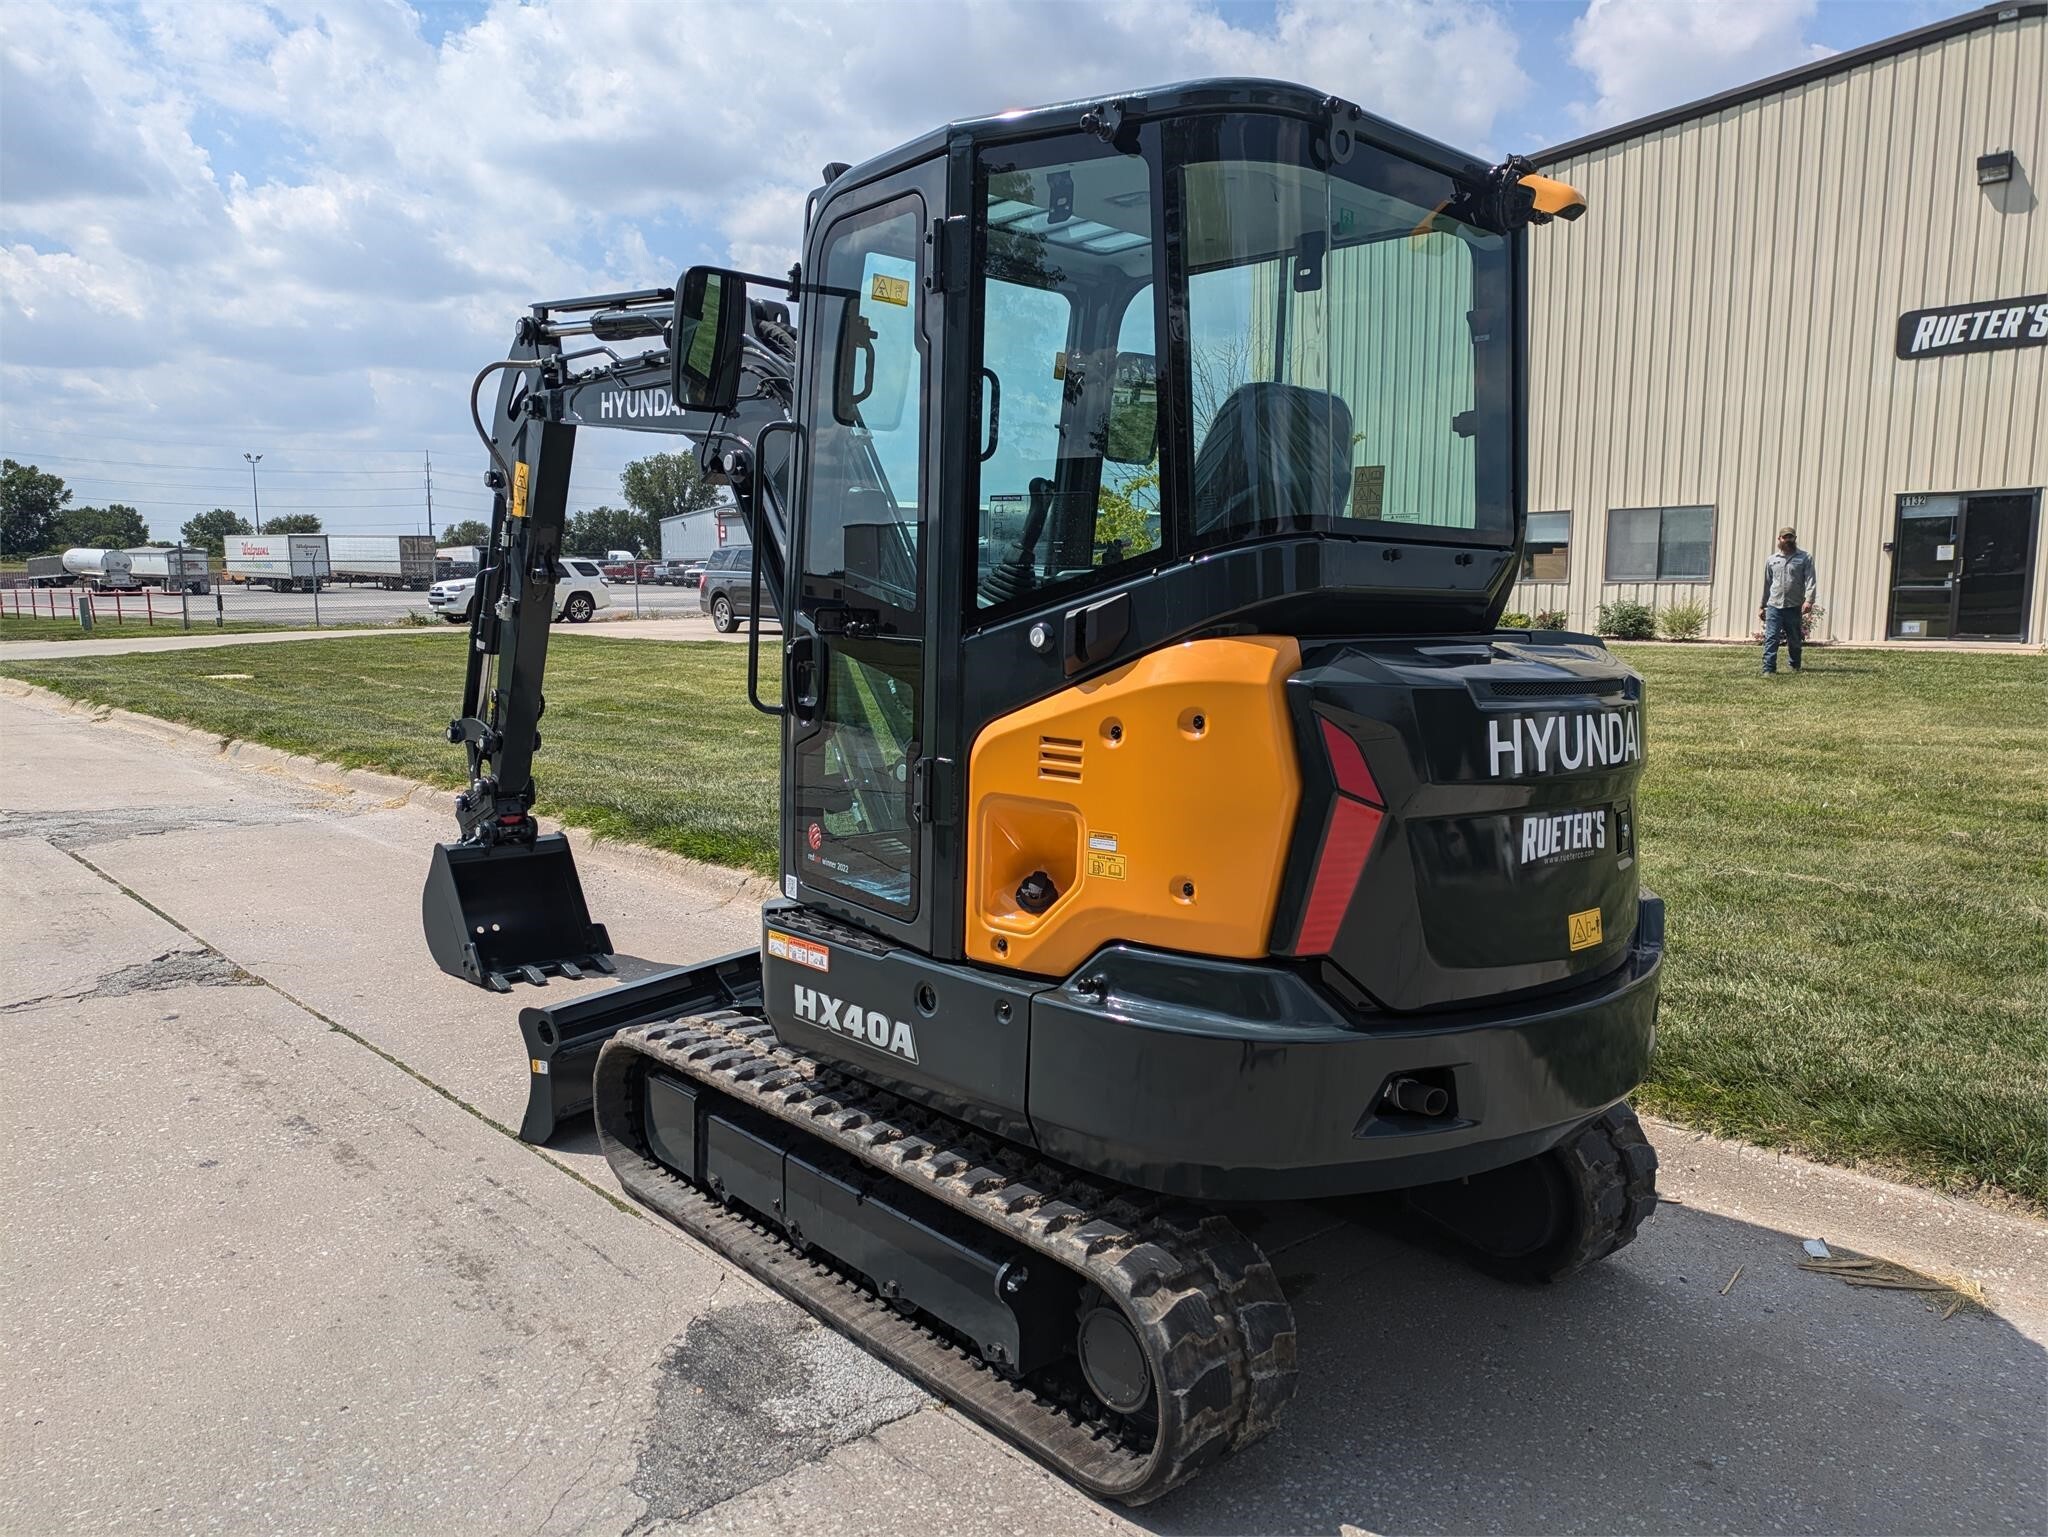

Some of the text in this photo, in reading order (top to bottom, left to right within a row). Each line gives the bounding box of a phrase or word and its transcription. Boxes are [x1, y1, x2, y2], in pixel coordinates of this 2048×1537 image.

[1911, 304, 2048, 353] RUETER'S
[601, 389, 686, 418] HYUNDA
[1903, 496, 1925, 505] 1132
[241, 542, 269, 558] Walgreens
[1489, 711, 1641, 777] HYUNDAI
[1521, 810, 1605, 865] RUETER'S
[822, 858, 837, 869] winner
[837, 862, 849, 874] 2022
[794, 984, 916, 1060] HX40A
